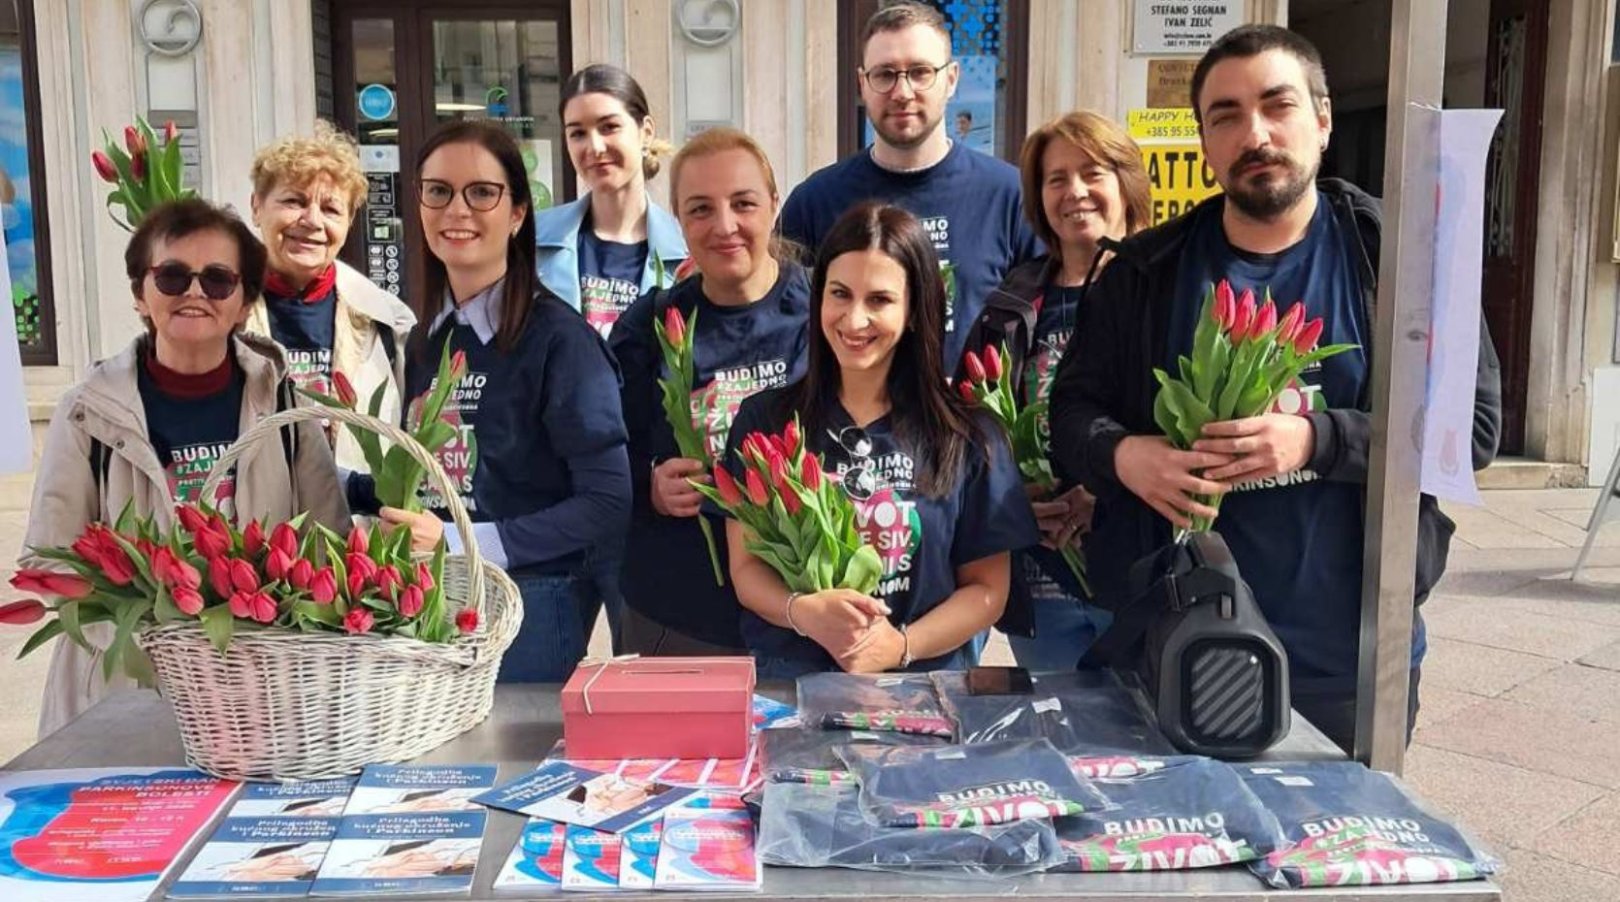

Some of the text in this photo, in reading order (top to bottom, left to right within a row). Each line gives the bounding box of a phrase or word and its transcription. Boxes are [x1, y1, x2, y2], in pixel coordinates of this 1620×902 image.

[1151, 5, 1227, 15] STEFANO SEGNAN
[1164, 18, 1186, 27] IVAN
[1139, 111, 1180, 122] HAPPY
[1148, 152, 1217, 189] ATTO
[288, 350, 331, 364] UDIM
[715, 361, 787, 382] BUDIMO
[443, 451, 473, 469] SIV.
[877, 530, 915, 550] SIV.
[77, 784, 216, 792] PARKINSONOVE
[135, 790, 212, 798] BOLESTI
[938, 781, 1050, 802] BUDIMO
[258, 819, 328, 828] Prilagodba
[379, 816, 449, 824] Prilagodba
[1103, 812, 1224, 836] BUDIMO
[1302, 815, 1421, 838] BUDIMO
